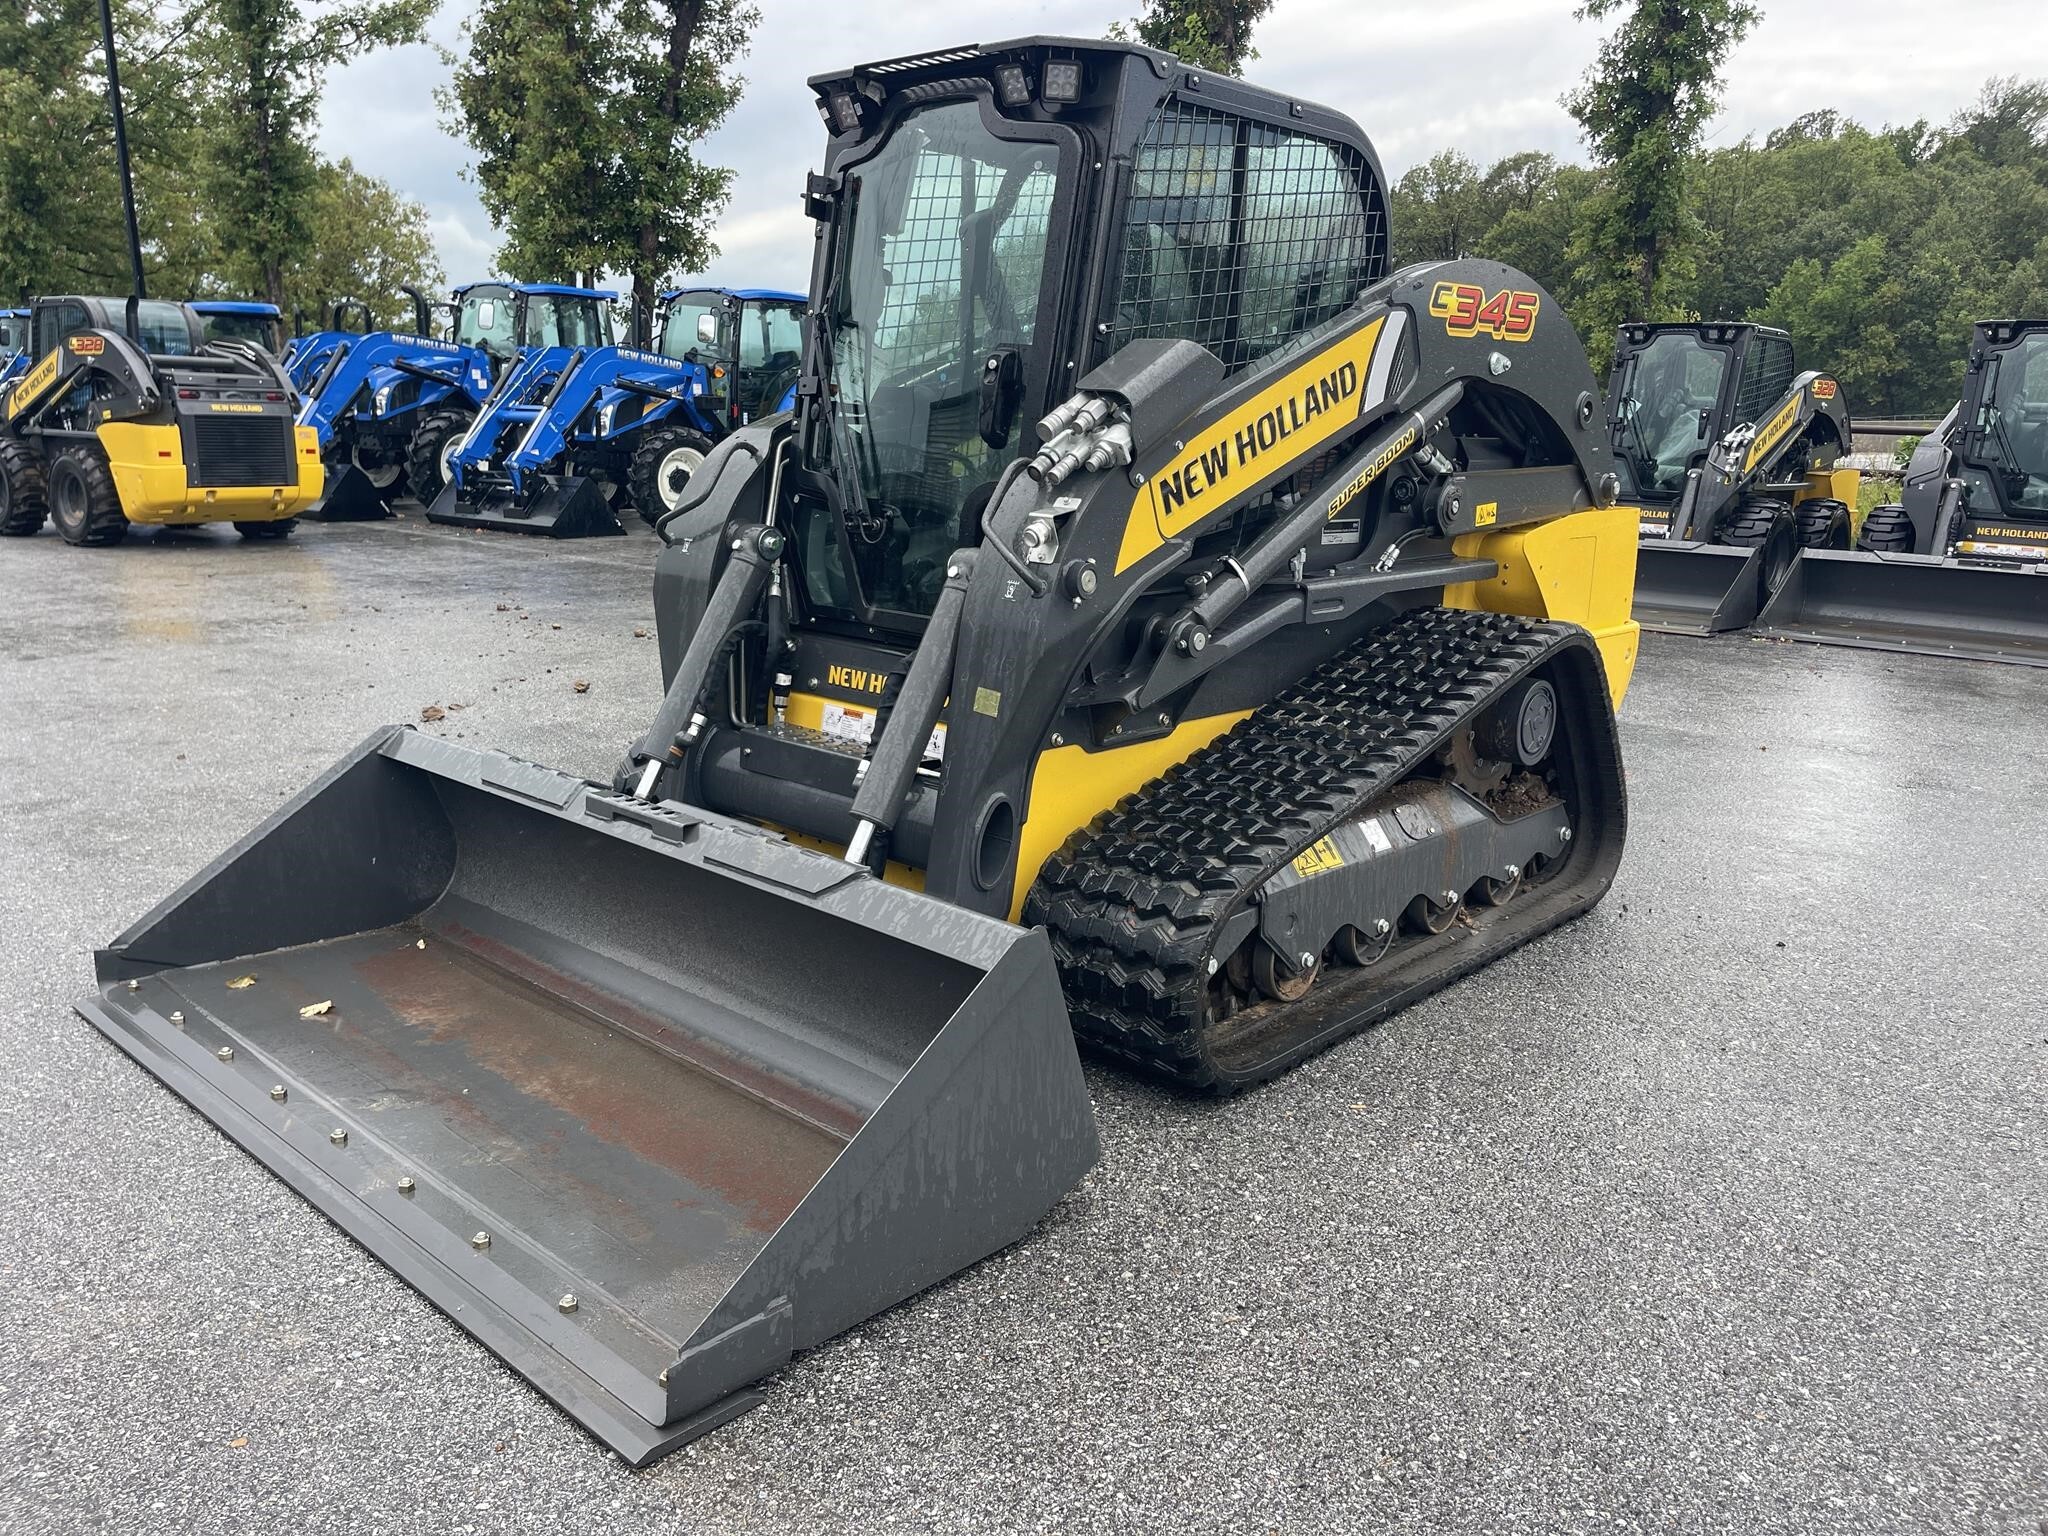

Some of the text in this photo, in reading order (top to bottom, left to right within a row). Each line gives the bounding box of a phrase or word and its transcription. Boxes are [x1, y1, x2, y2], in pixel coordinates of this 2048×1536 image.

[1430, 281, 1540, 341] C345
[392, 333, 459, 353] NEW HOLLAND
[617, 348, 683, 370] NEW HOLLAND
[17, 387, 30, 401] NEW
[29, 362, 55, 389] HOLLAND
[210, 403, 229, 412] NEW
[1159, 360, 1357, 516] NEW HOLLAND
[1753, 434, 1769, 456] NEW
[1767, 406, 1794, 441] HOLLAND
[1328, 427, 1415, 520] SUPER BOOM
[1976, 527, 2048, 540] NEW HOLLAND
[828, 664, 868, 691] NEW
